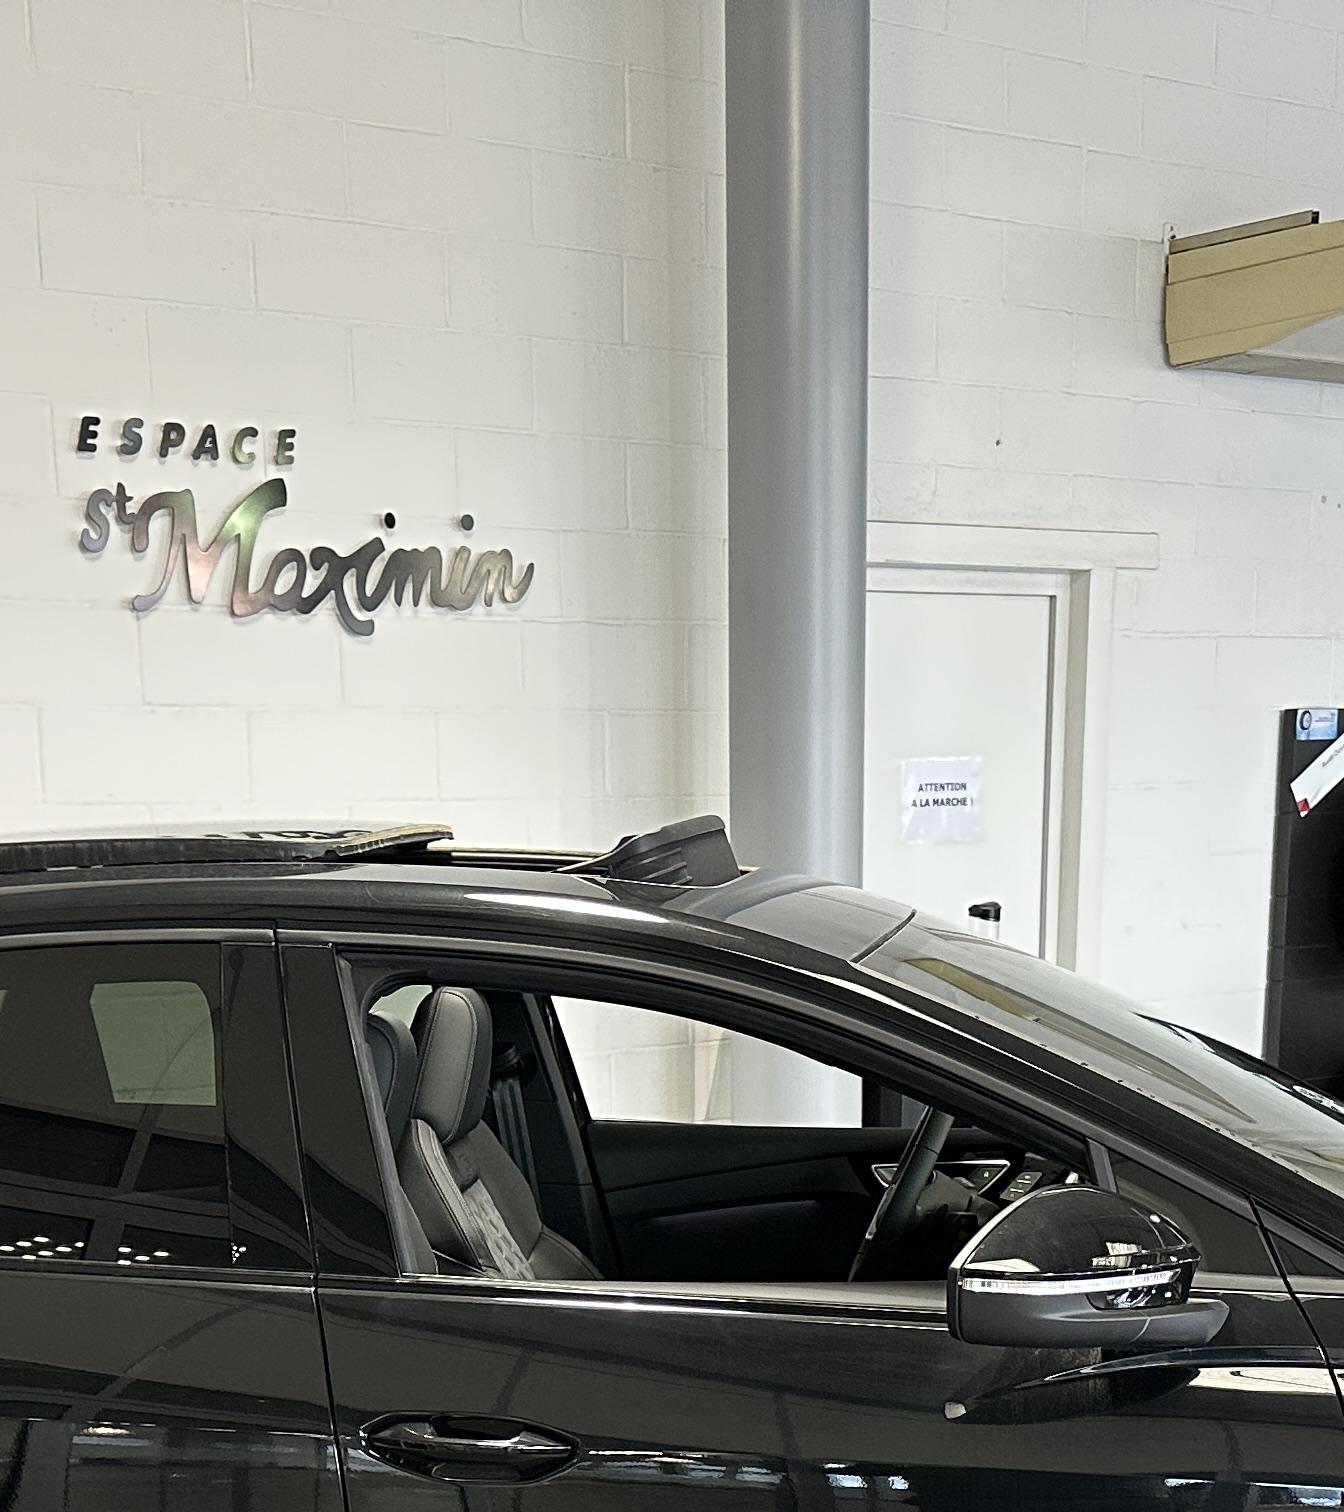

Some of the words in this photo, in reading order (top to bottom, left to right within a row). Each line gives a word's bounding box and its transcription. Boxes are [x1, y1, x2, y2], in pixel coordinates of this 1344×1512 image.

[76, 416, 297, 465] ESPACE
[131, 478, 535, 636] Maximin
[918, 782, 967, 792] ATTENTION
[919, 798, 930, 807] LA
[932, 797, 968, 807] MARCHE
